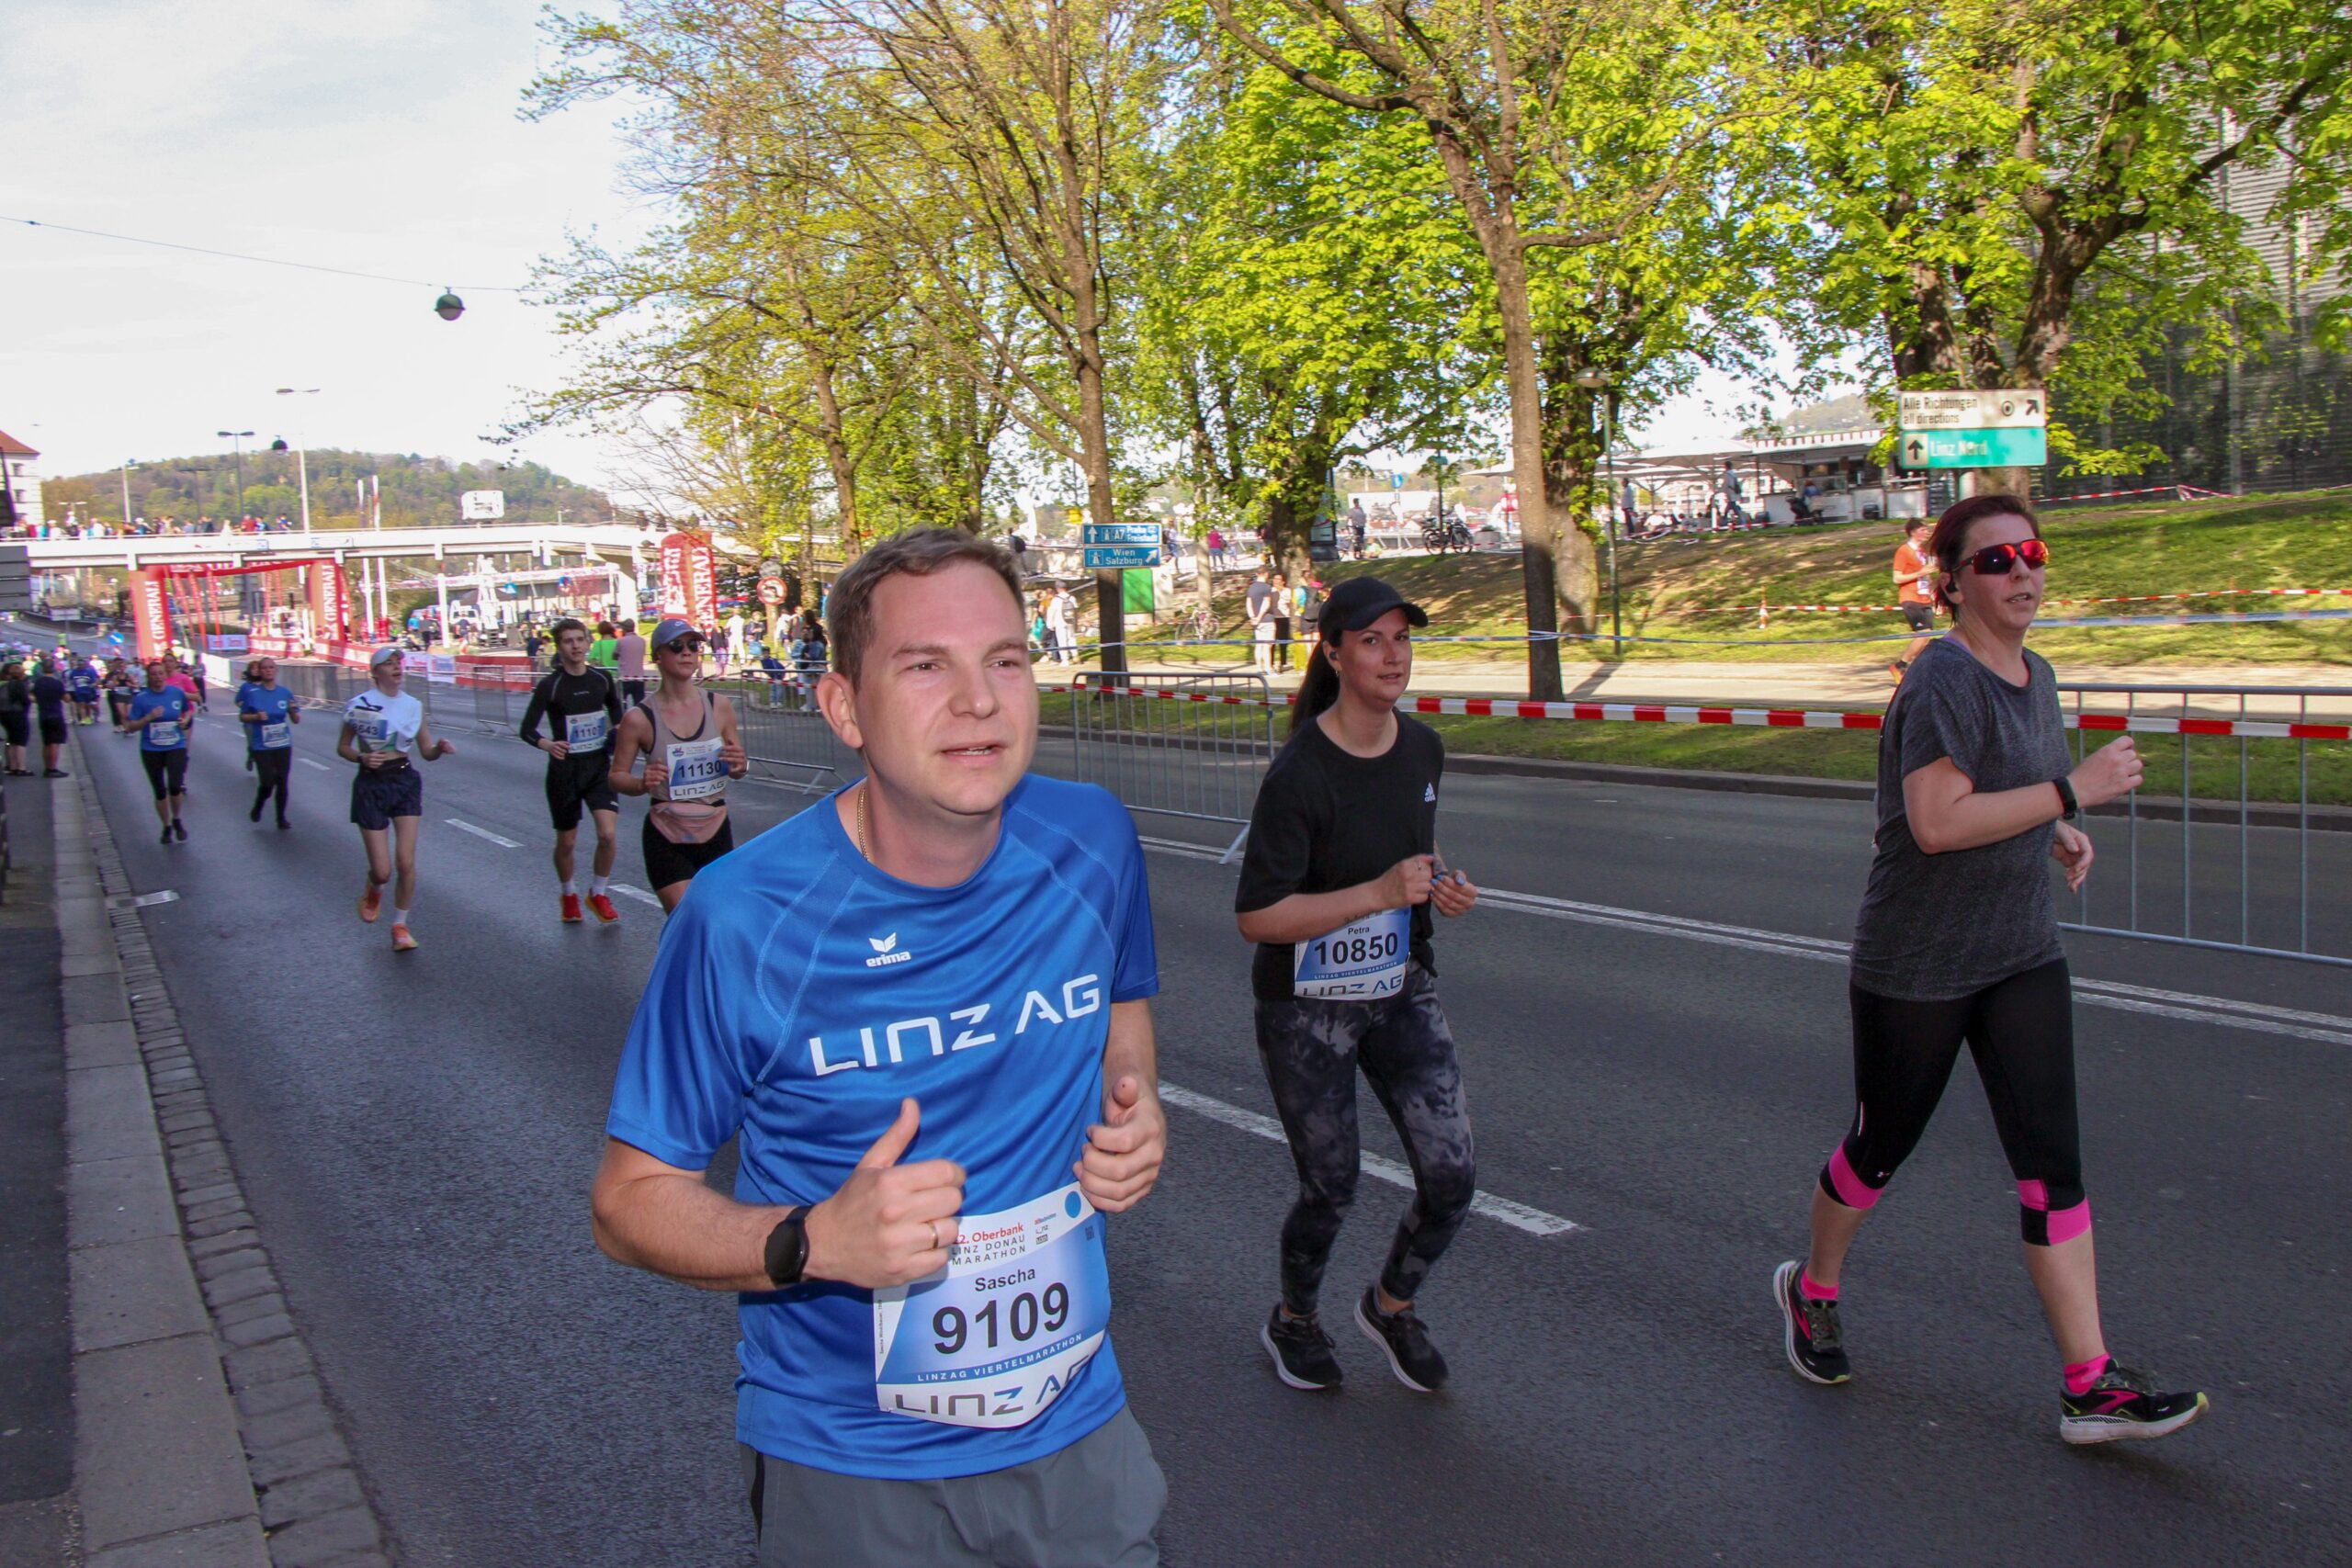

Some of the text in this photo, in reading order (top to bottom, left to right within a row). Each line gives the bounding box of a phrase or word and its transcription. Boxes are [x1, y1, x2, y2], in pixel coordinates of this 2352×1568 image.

[1904, 397, 1977, 412] Alle Richtungen
[1904, 413, 1960, 424] all directions
[1930, 440, 1987, 457] Linz Nord
[1114, 528, 1125, 540] A7
[1113, 548, 1136, 557] Wien
[1105, 558, 1143, 566] Salzburg
[678, 761, 721, 778] 11130
[708, 781, 724, 791] AG
[1348, 927, 1370, 935] Petra
[1314, 932, 1398, 965] 10850
[865, 950, 911, 967] erima
[1372, 974, 1403, 994] AG
[809, 974, 1100, 1076] LINZ AG
[972, 1222, 1024, 1244] Oberbank
[952, 1245, 978, 1256] LINZ
[986, 1235, 1025, 1251] DONAU
[952, 1245, 1026, 1266] MARATHON
[975, 1268, 1035, 1292] Sascha
[933, 1281, 1069, 1355] 9109
[918, 1334, 1082, 1382] LINZAG VIERTELMARATHON
[895, 1386, 1023, 1417] LINZ
